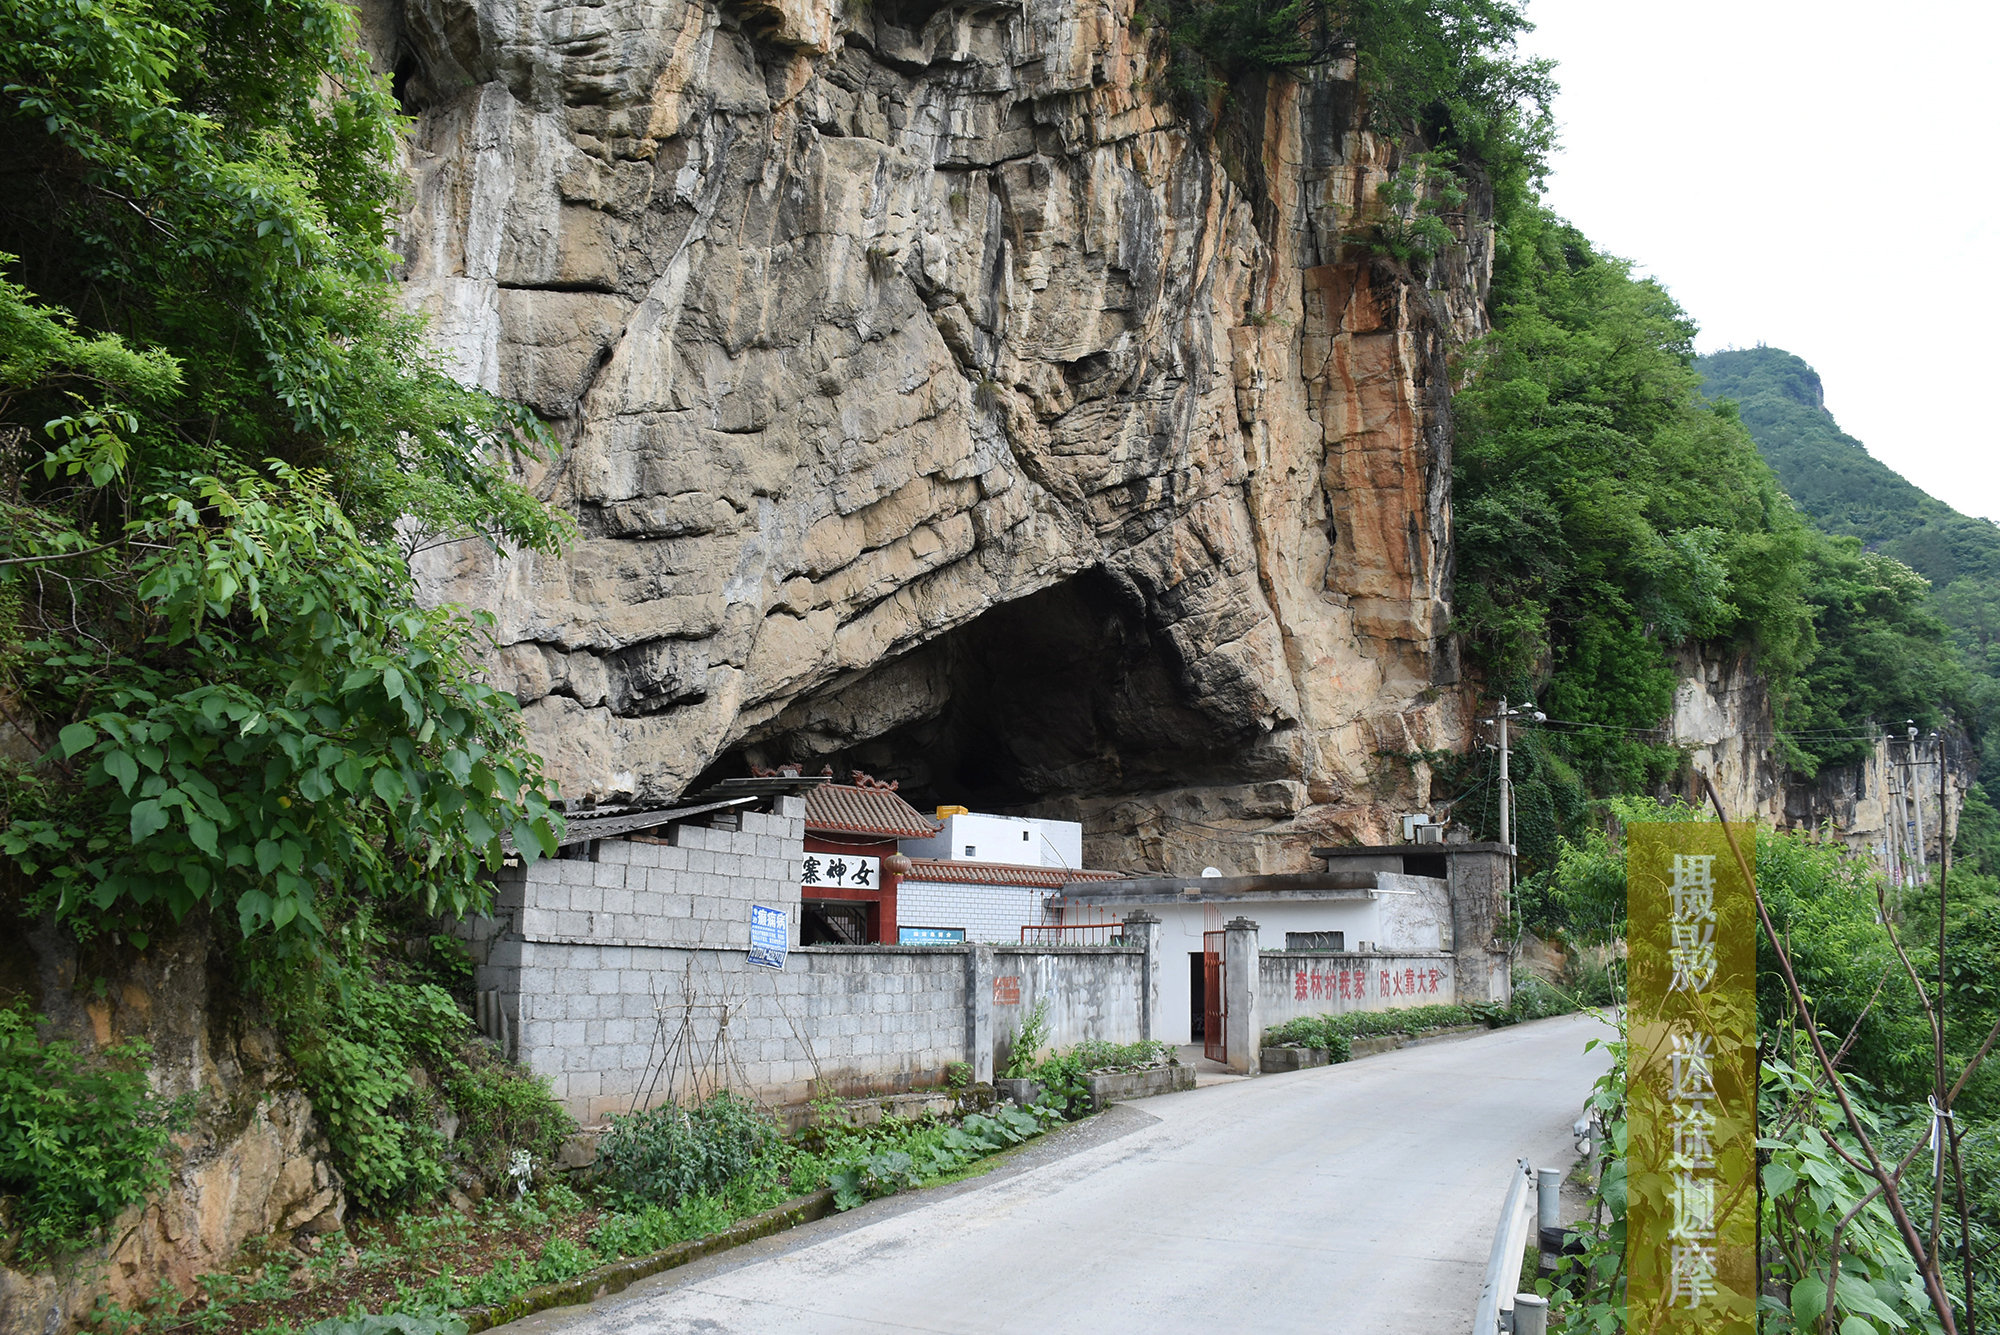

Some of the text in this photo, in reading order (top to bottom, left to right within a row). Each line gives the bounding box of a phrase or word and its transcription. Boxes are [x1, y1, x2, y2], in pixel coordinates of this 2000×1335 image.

[1295, 967, 1439, 1001] 森林护我家 防火靠大家
